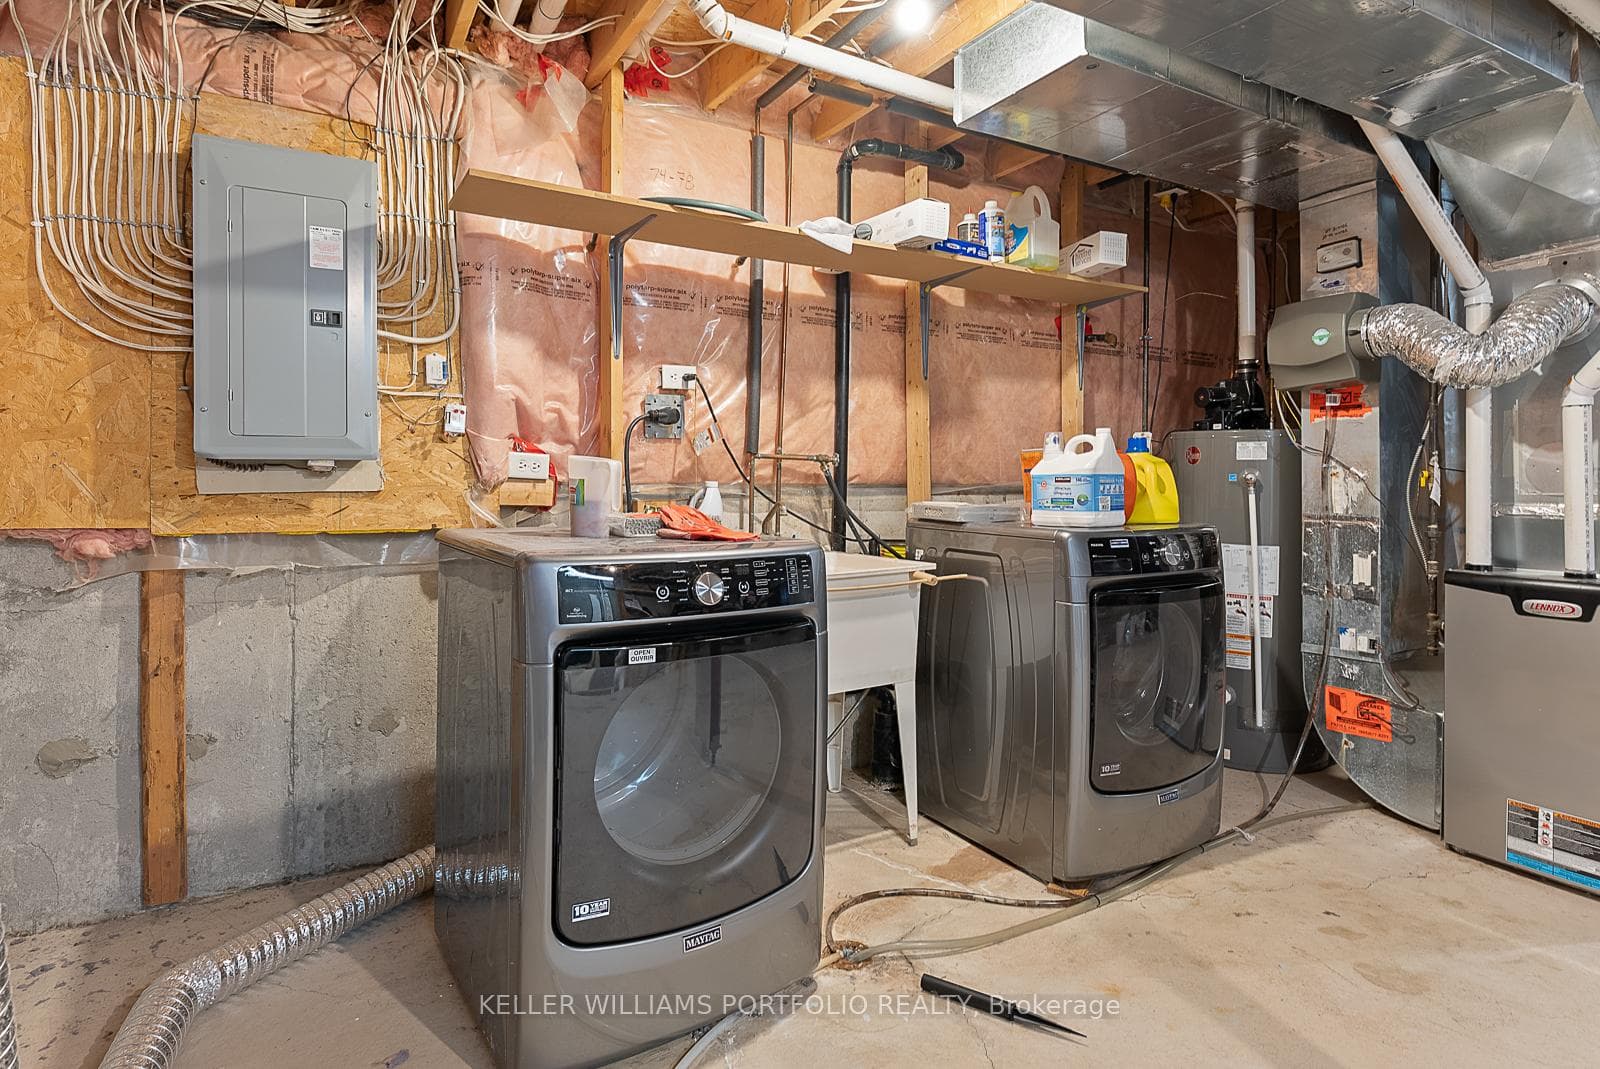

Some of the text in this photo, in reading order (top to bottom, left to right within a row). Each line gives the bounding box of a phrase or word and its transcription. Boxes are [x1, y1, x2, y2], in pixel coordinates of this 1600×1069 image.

[1530, 602, 1566, 612] LENNOX
[574, 904, 590, 917] 10
[686, 930, 720, 949] MAYTAG
